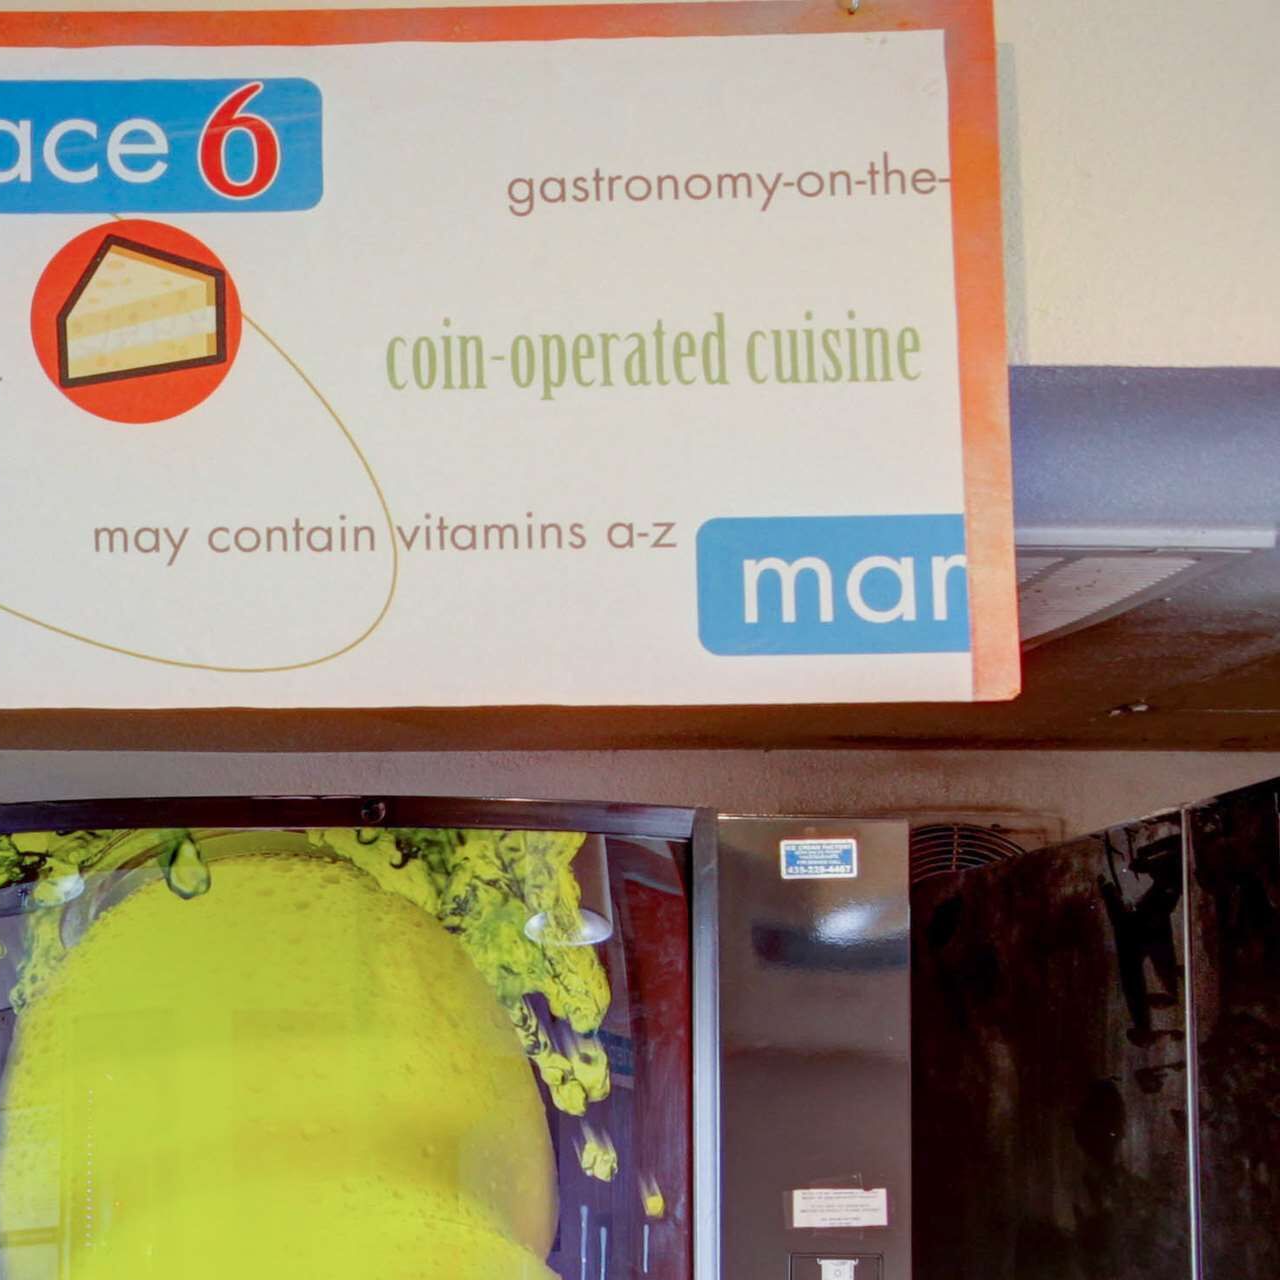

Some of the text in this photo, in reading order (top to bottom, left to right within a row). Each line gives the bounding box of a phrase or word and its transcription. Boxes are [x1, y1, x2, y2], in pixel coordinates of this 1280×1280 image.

[195, 81, 282, 201] 6
[384, 308, 923, 401] coin-operated cuisine
[92, 511, 679, 567] may contain vitamins a-z
[740, 552, 968, 625] mar
